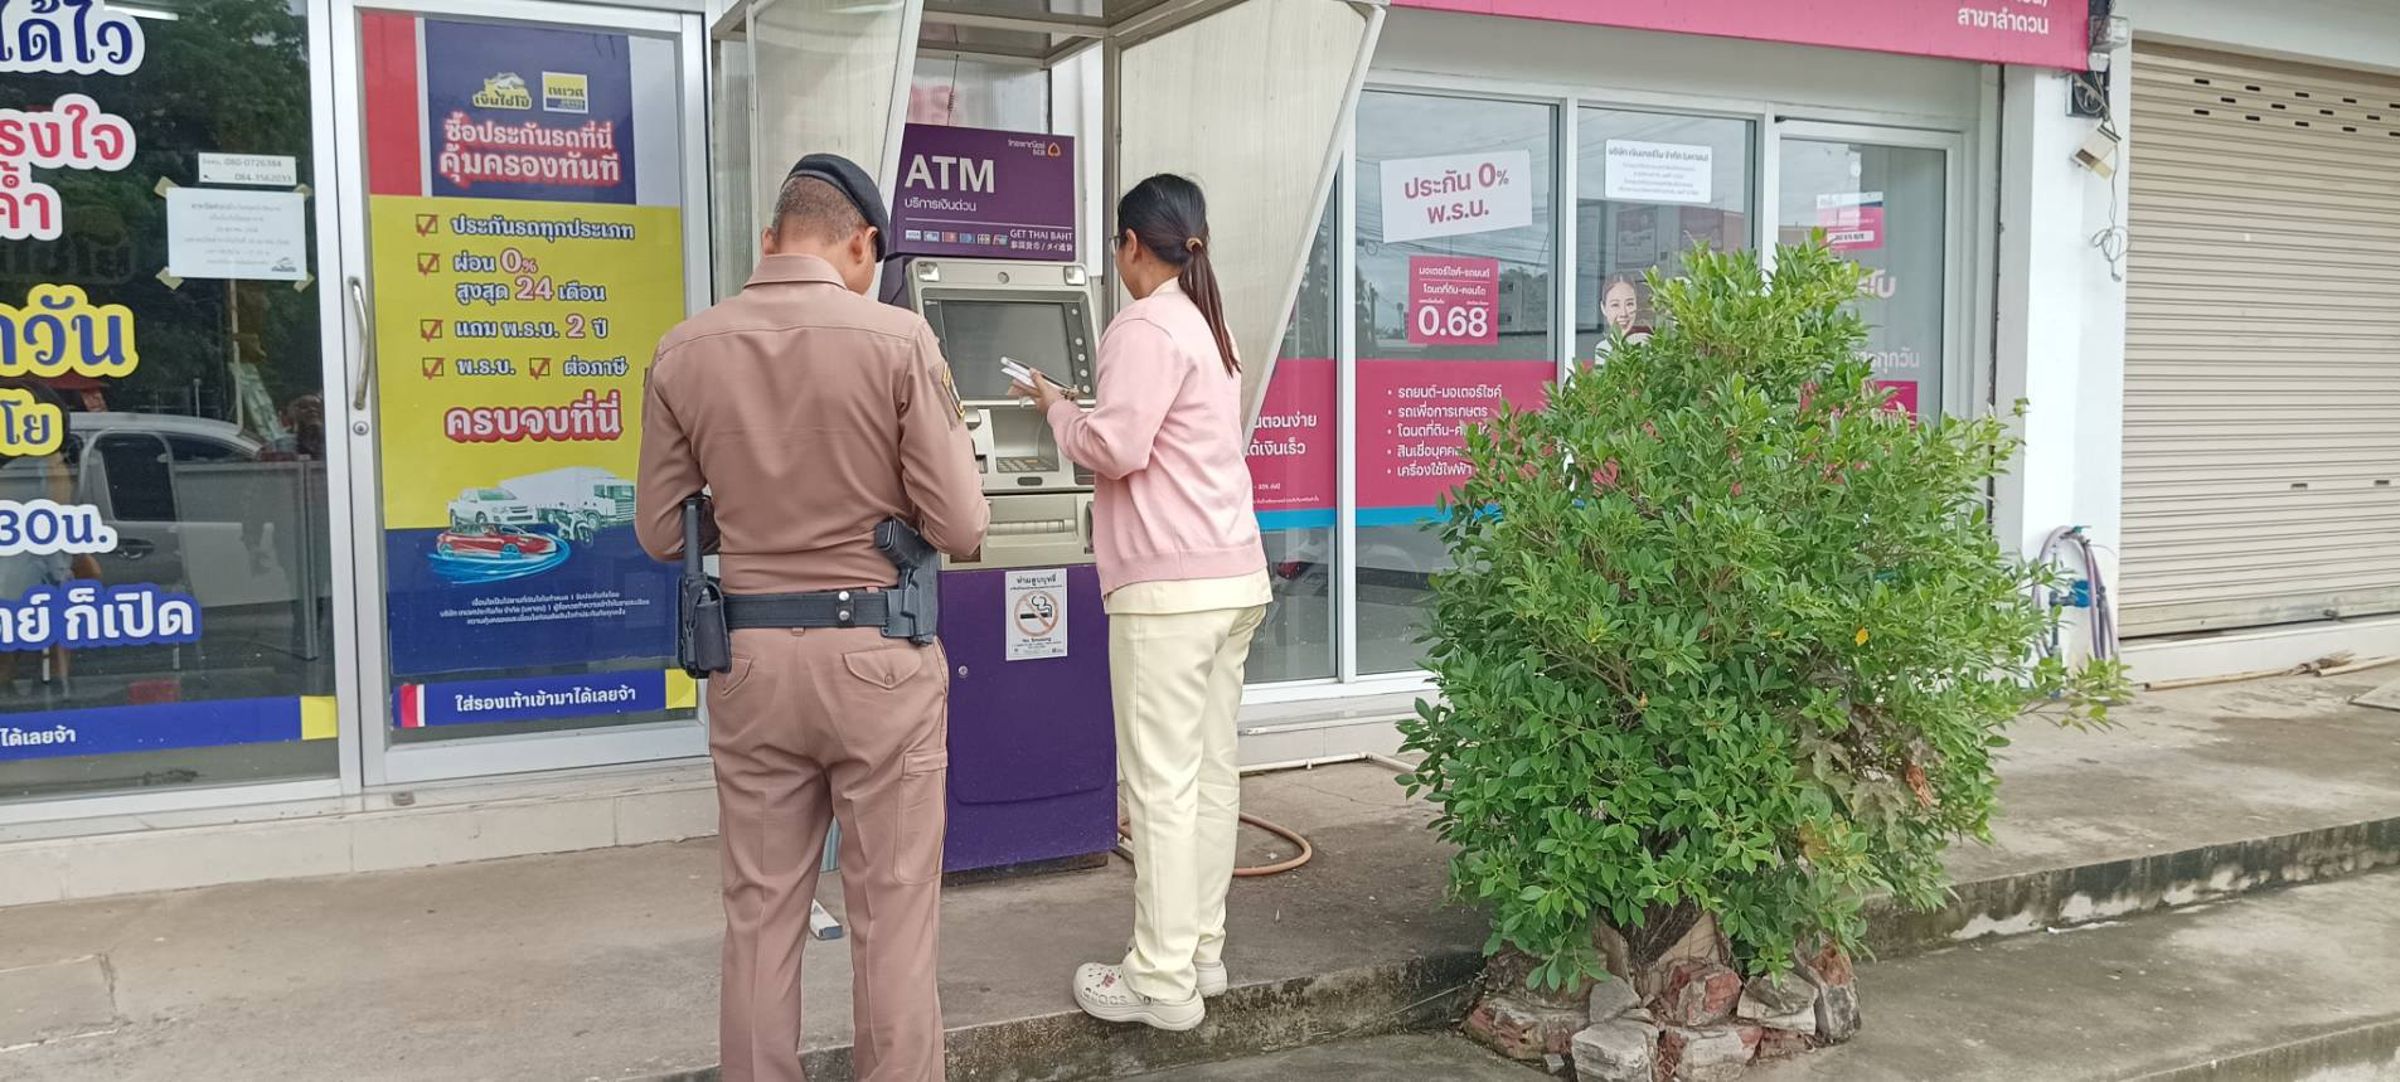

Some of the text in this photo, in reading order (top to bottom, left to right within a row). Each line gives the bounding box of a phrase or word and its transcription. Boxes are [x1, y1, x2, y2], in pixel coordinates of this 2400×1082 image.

[1957, 7, 2049, 35] สาขาลำดวน
[444, 111, 614, 150] ซื้อประกันรถที่นี่
[439, 143, 620, 182] คุ้มครองทันที
[904, 154, 996, 194] ATM
[1404, 162, 1509, 200] ประกัน 0%
[904, 197, 977, 212] บริการเงินด่วน
[1427, 199, 1490, 225] พ.ร.บ.
[450, 213, 636, 243] ประกันรถทุกประเภท
[1010, 229, 1072, 241] GET THAI BAHT
[453, 248, 538, 274] ผ่อน 0%
[455, 275, 607, 306] สูงสุด 24 เดือน
[454, 314, 608, 339] แถม พ.ร.บ. 2 ปี
[1418, 305, 1488, 337] 0.68
[456, 355, 629, 377] พ.ร.บ. ต่อภาษี
[445, 391, 622, 438] ครบจบที่นี่
[1398, 401, 1489, 418] รถเพื่อการเกษตร
[1246, 437, 1306, 456] ด้เงินเร็ว
[64, 587, 193, 641] ก็เปิด
[455, 686, 637, 712] ใส่รองเท้าเข้ามาได้เลยจ้า
[0, 725, 77, 747] ได้เลยจ้า
